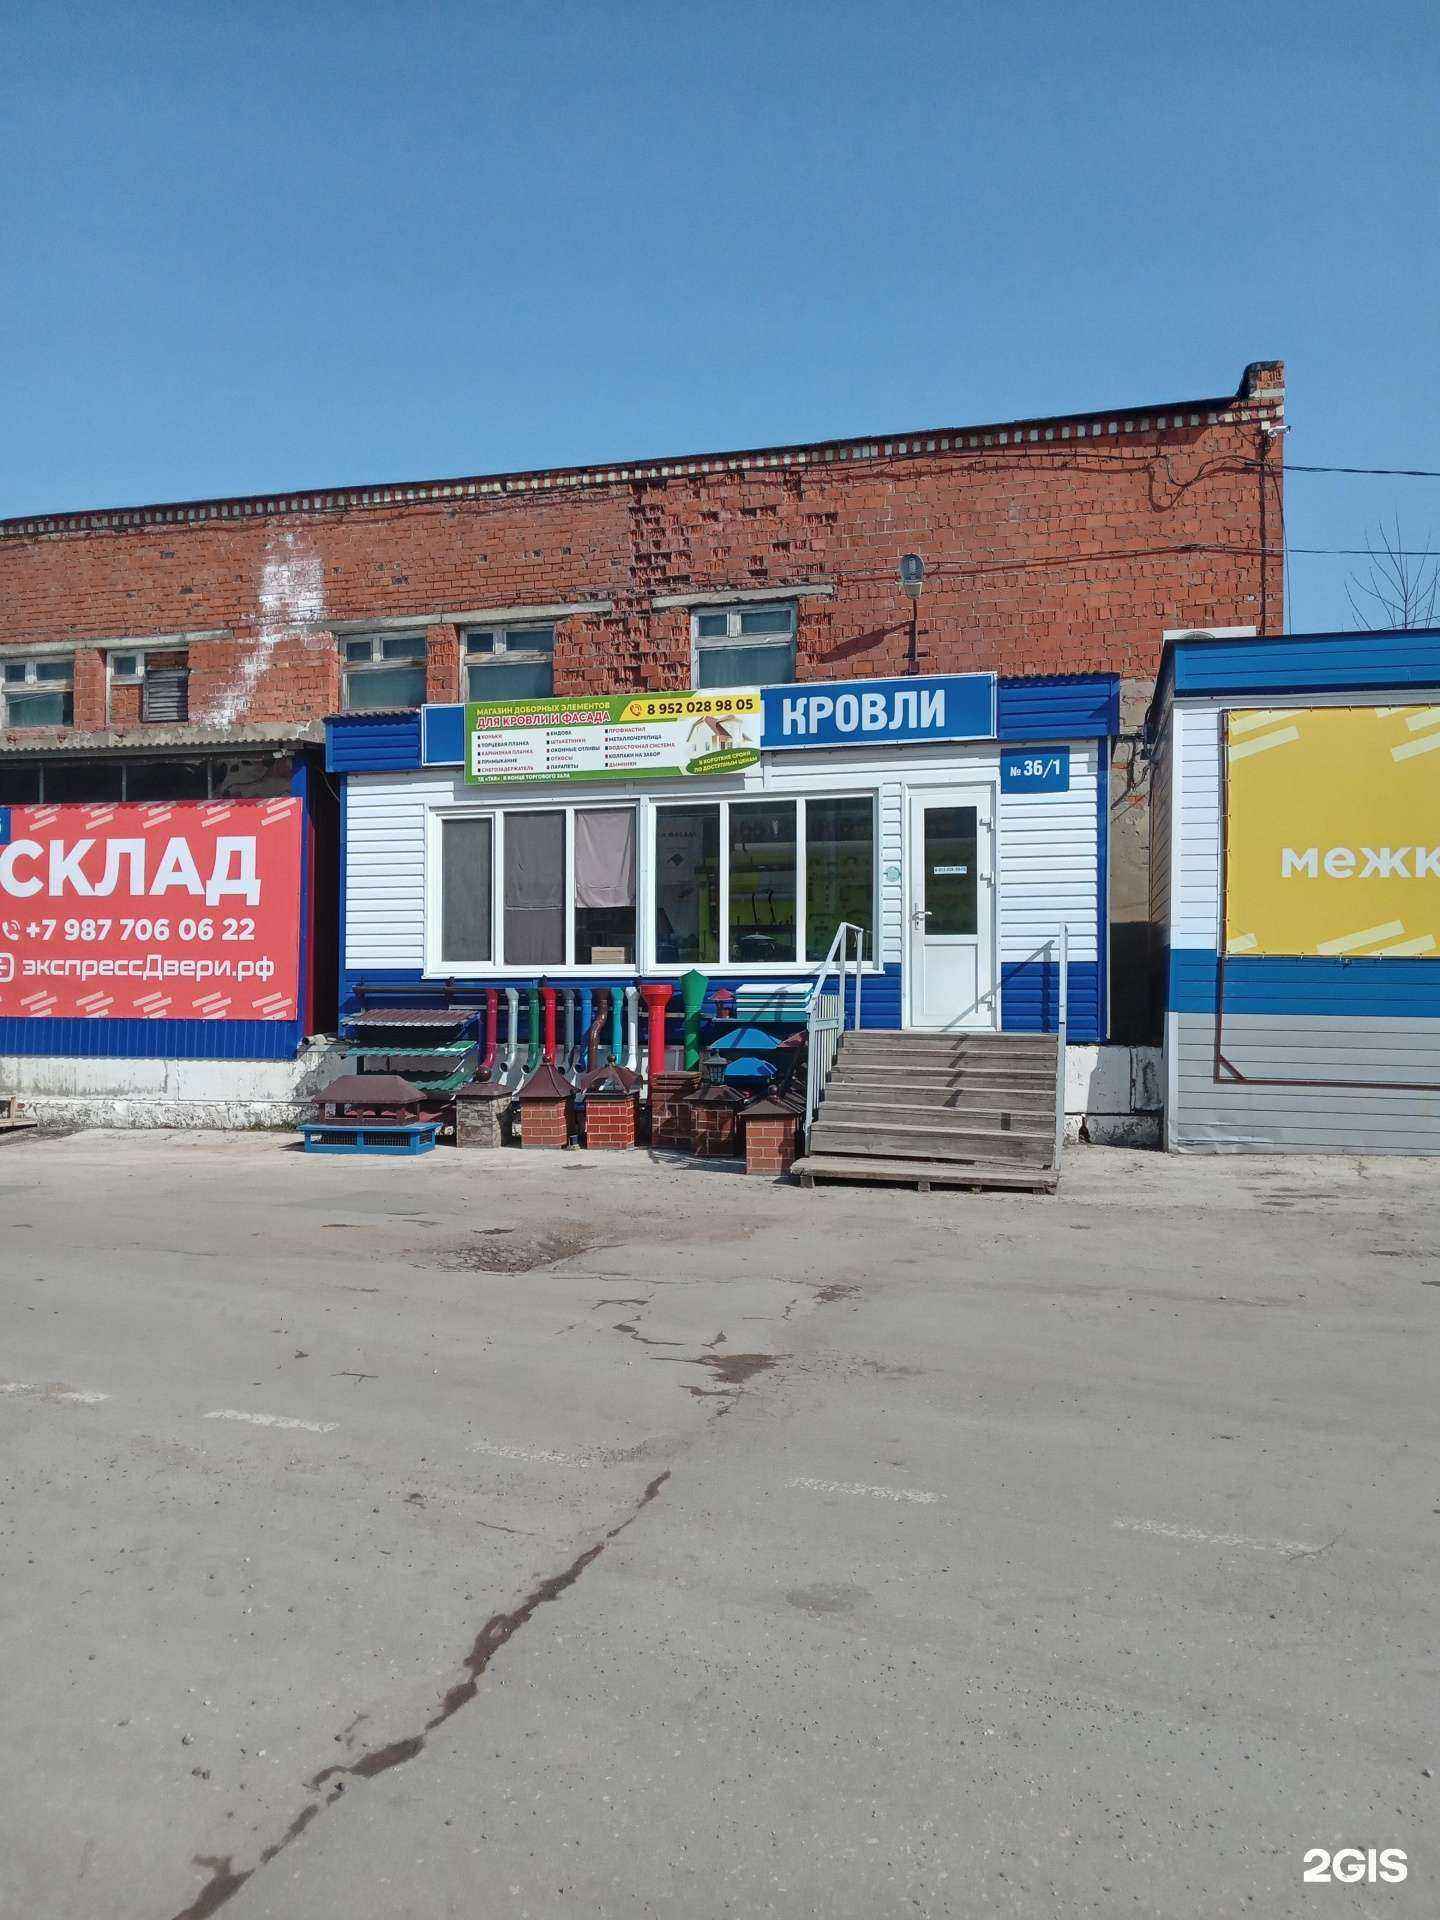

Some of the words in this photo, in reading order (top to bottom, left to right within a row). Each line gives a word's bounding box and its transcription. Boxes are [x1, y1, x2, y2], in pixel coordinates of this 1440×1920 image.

[476, 708, 513, 716] МАГАЗИН
[514, 705, 559, 715] ДОБОРНЫХ
[561, 702, 610, 711] ЭЛЕМЕНТОВ
[647, 704, 655, 715] 8
[659, 703, 683, 714] 952
[686, 701, 711, 713] 028
[715, 700, 732, 711] 98
[736, 699, 753, 710] 05
[782, 689, 945, 736] КРОВЛИ
[477, 716, 500, 730] ДЛЯ
[503, 714, 550, 727] КРОВЛИ
[551, 712, 560, 724] И
[561, 711, 611, 725] ФАСАДА
[1010, 766, 1021, 777] №
[1023, 759, 1060, 778] 36/1
[0, 836, 262, 906] СКЛАД
[26, 919, 57, 941] +7
[63, 918, 112, 941] 987
[119, 918, 170, 941] 706
[178, 918, 214, 941] 06
[221, 918, 256, 941] 22
[22, 953, 275, 982] экспрессДвери.рф
